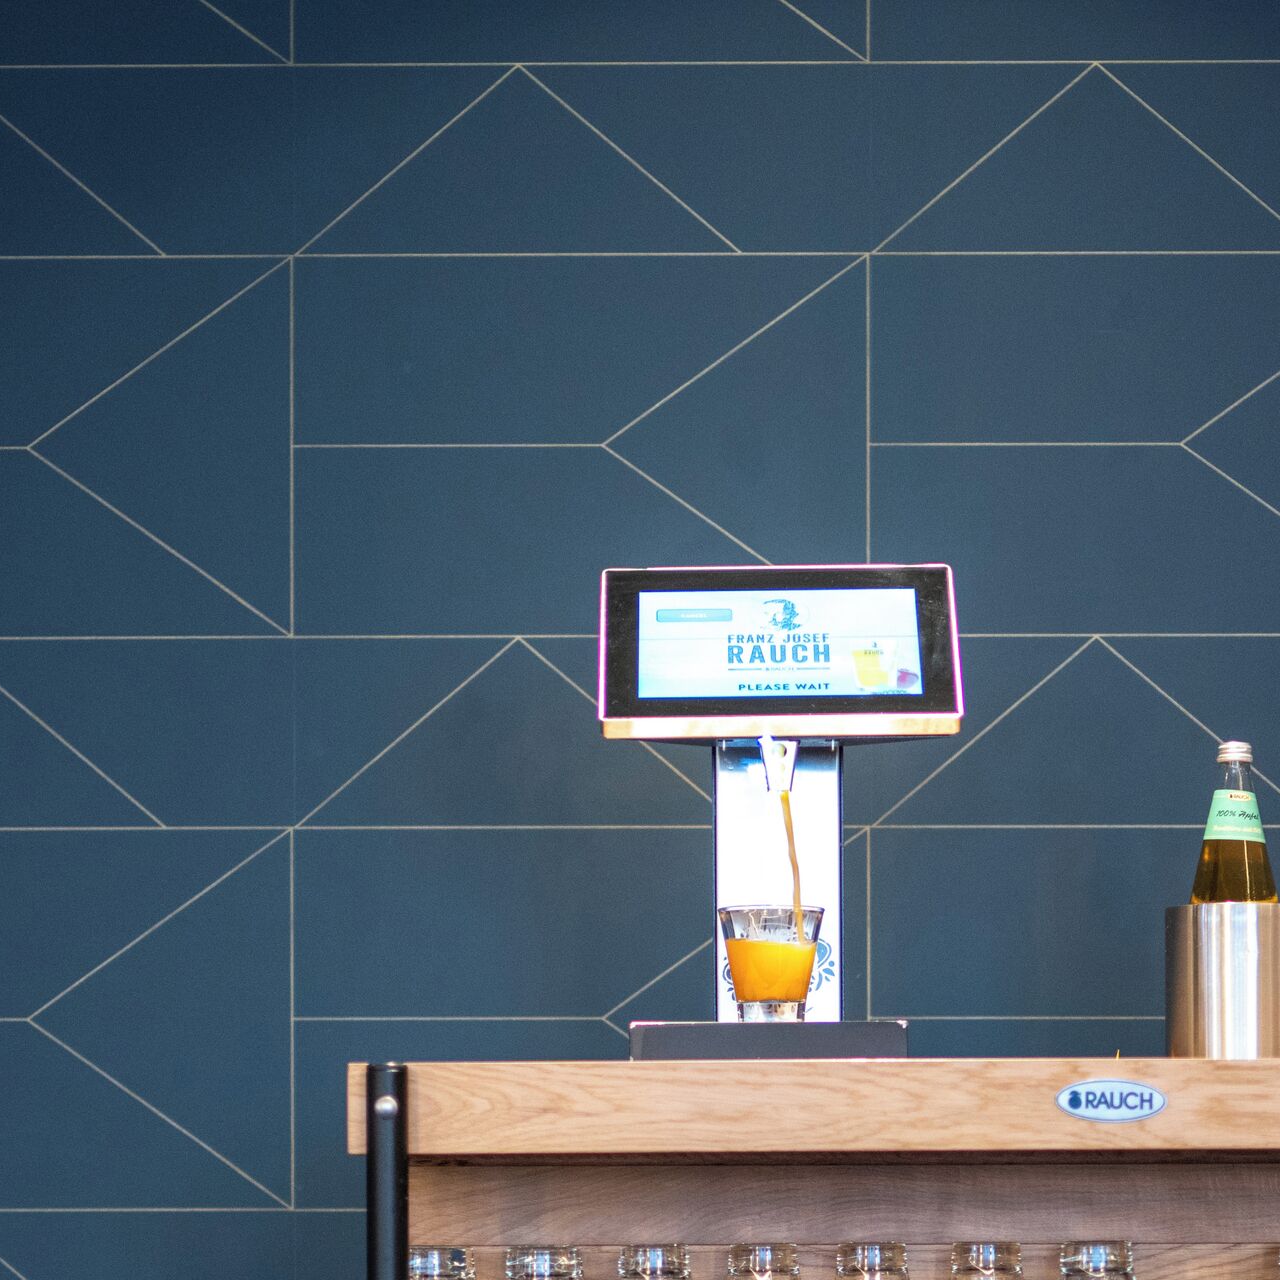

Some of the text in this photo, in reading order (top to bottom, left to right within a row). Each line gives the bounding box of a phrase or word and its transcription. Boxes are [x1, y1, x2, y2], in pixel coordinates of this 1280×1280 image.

[727, 633, 830, 644] FRANZ JOSEF
[727, 643, 831, 664] RAUCH
[738, 682, 831, 691] PLEASE WAIT
[1216, 809, 1237, 817] 100%
[1084, 1090, 1154, 1110] RAUCH
